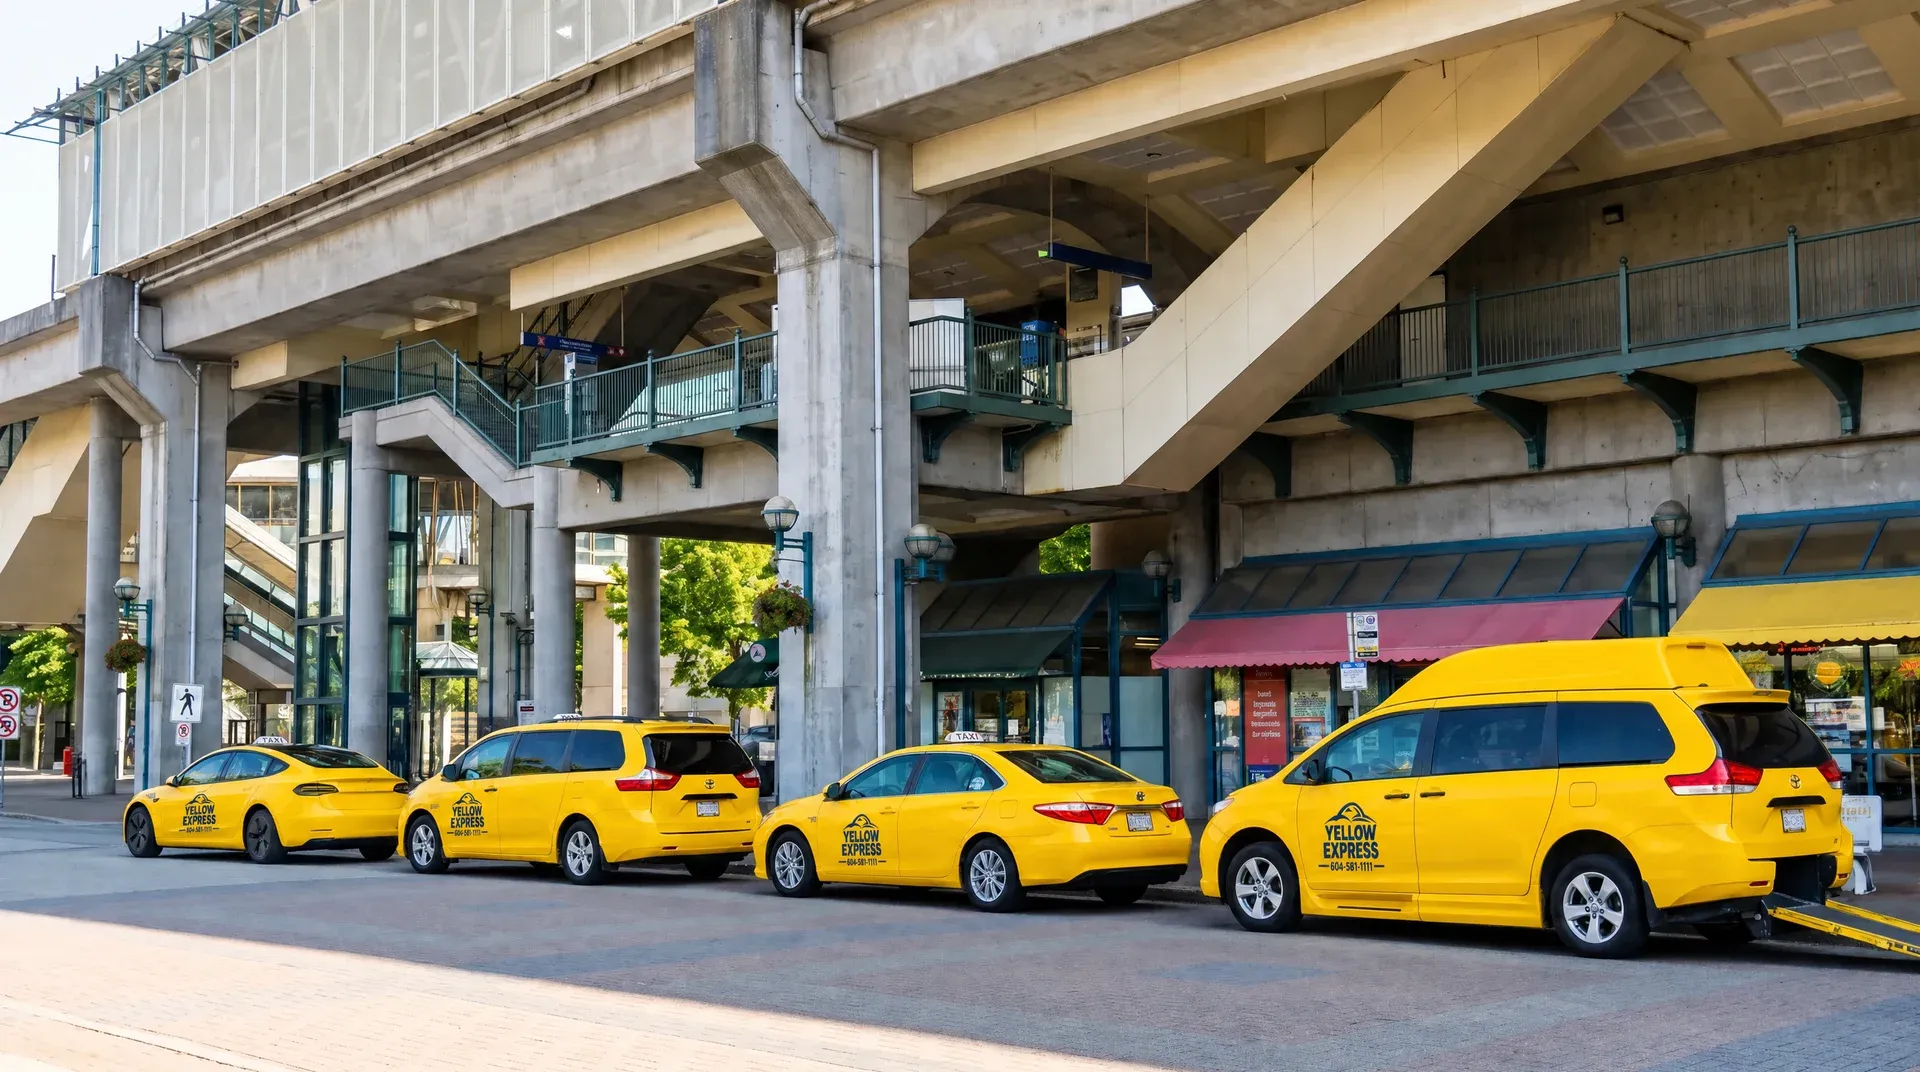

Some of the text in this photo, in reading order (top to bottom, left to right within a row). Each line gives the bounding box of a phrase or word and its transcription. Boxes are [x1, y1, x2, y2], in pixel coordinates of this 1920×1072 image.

[185, 805, 215, 815] YELLOW
[452, 806, 482, 817] YELLOW
[182, 814, 216, 826] EXPRESS
[450, 816, 485, 828] EXPRESS
[843, 830, 880, 842] YELLOW
[1325, 824, 1377, 841] YELLOW
[841, 843, 882, 857] EXPRESS
[1323, 841, 1379, 859] EXPRESS
[846, 858, 878, 866] 604-581-1111
[1330, 861, 1373, 871] 604-581-1111
